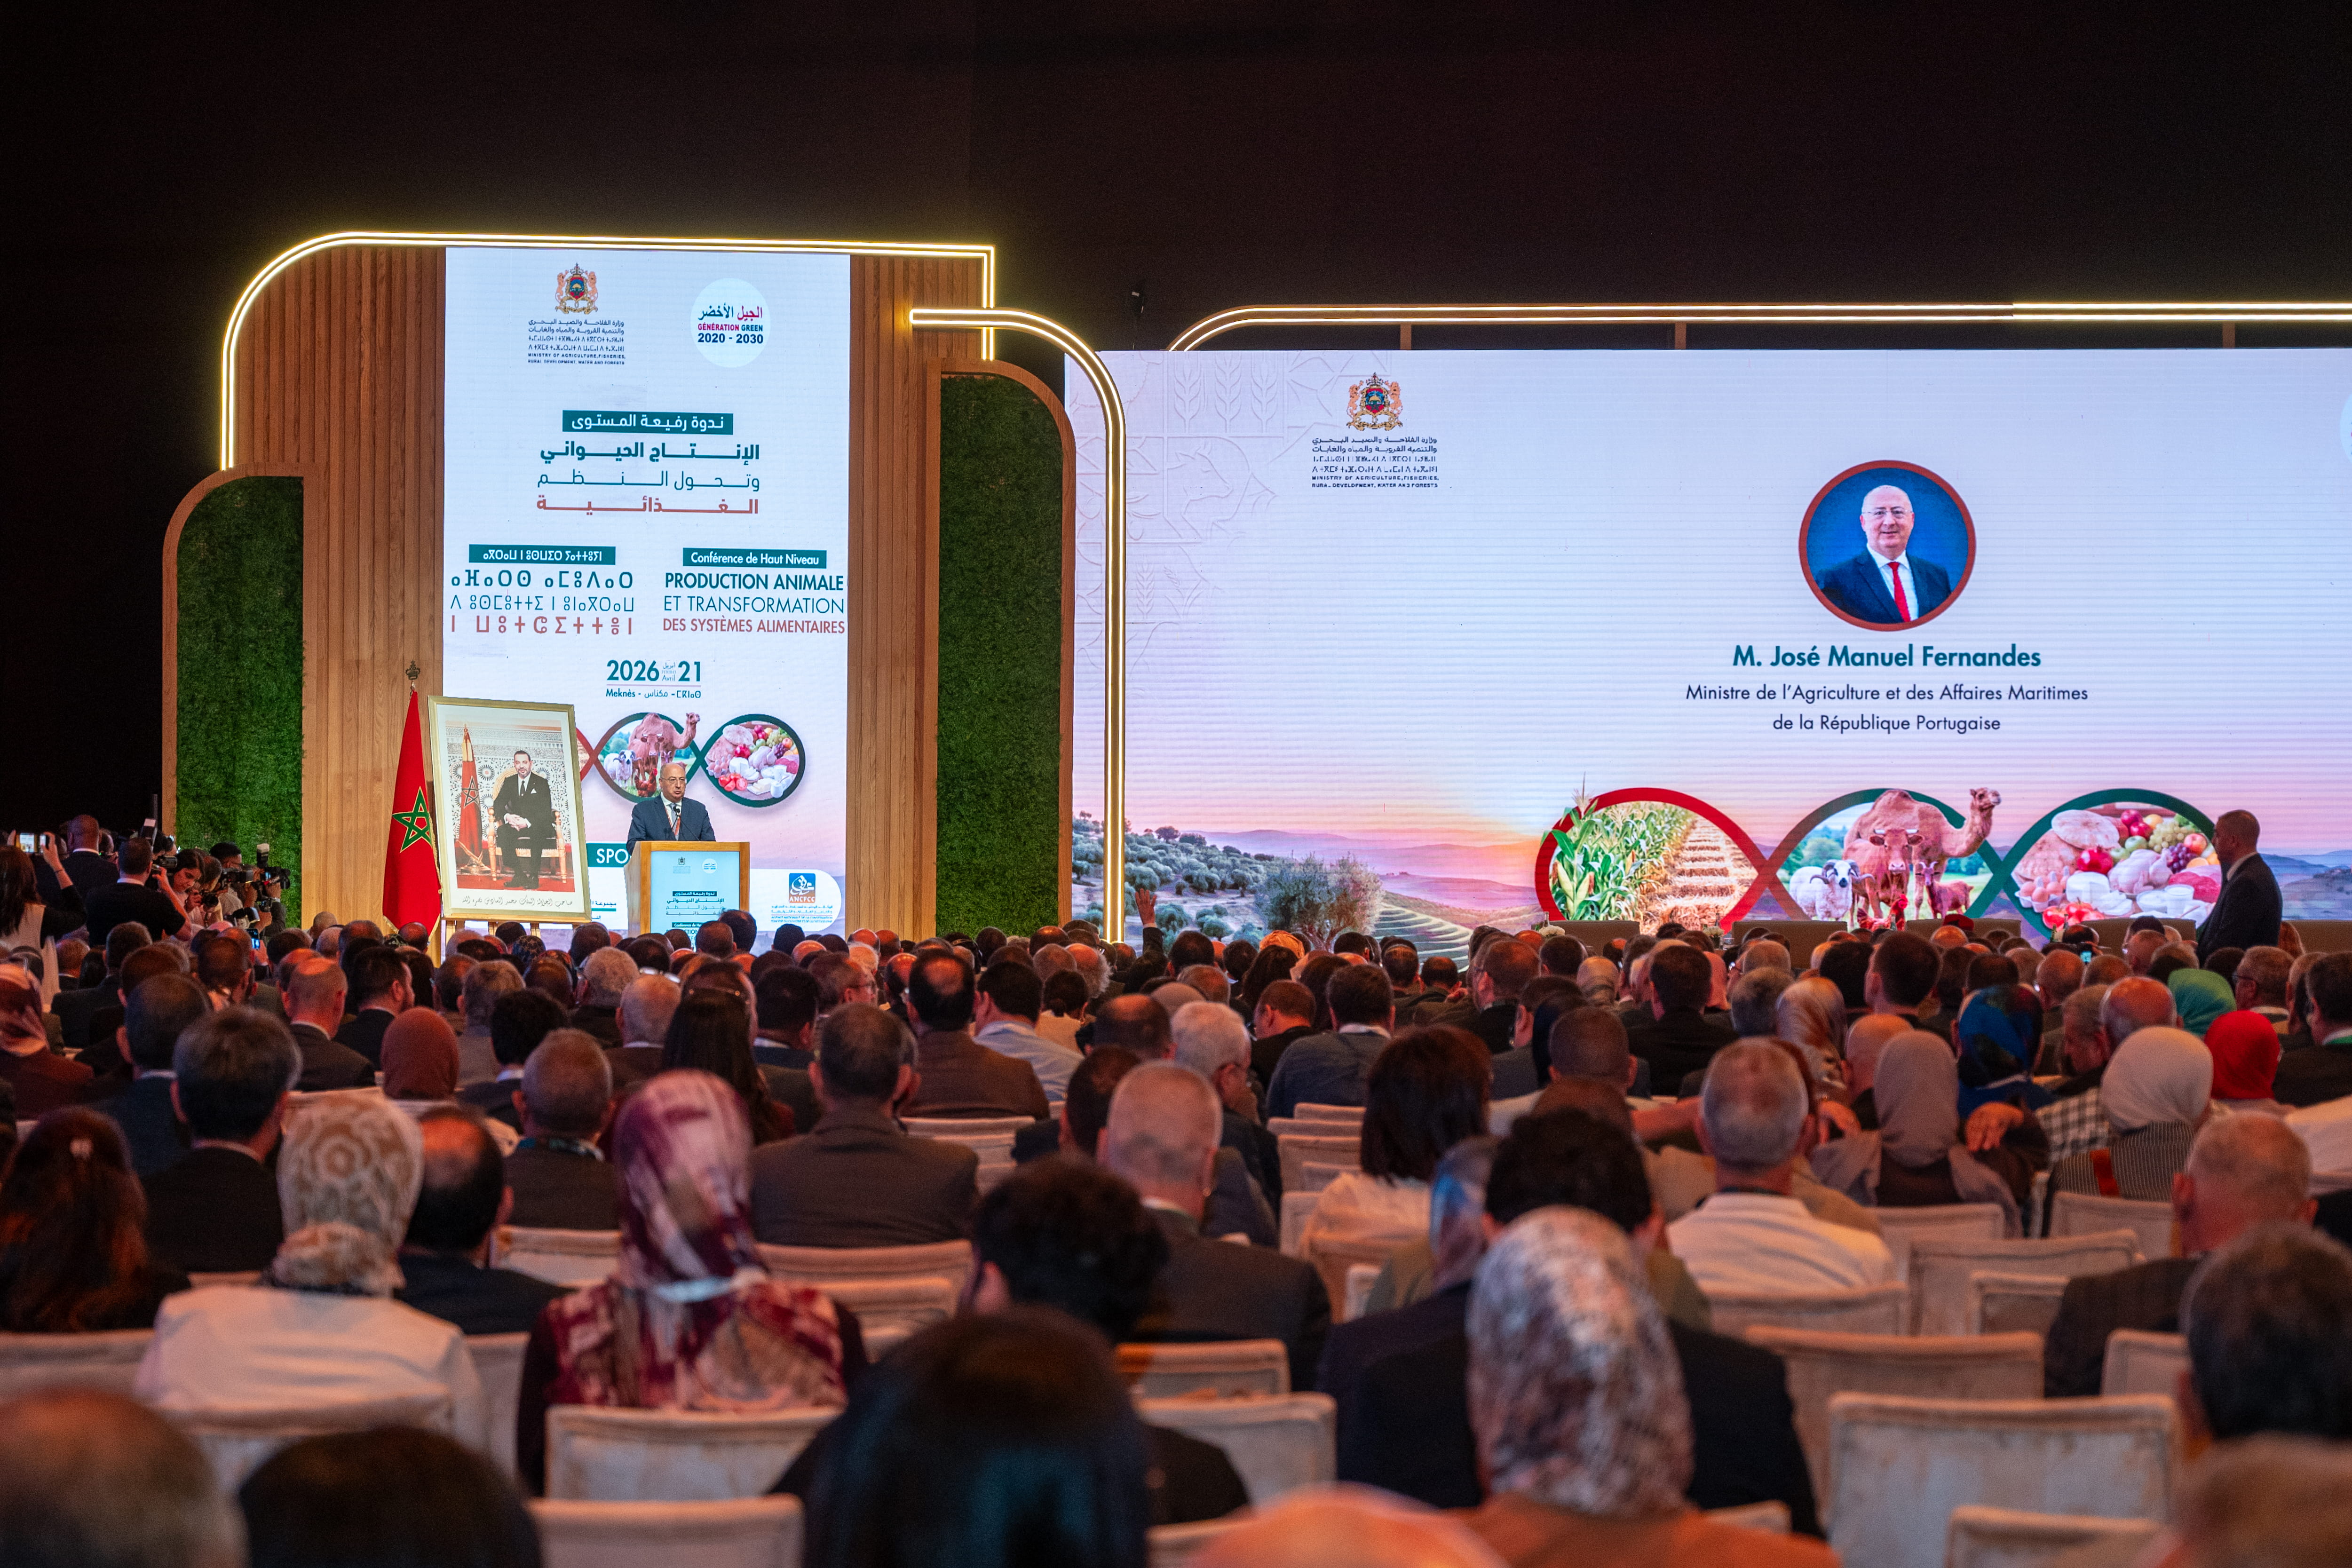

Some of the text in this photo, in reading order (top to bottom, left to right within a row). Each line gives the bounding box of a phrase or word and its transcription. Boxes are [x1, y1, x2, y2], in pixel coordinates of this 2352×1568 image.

[698, 302, 762, 321] الجيل الأخضر
[698, 322, 739, 331] GÉNÉRATION
[698, 333, 725, 343] 2020
[736, 334, 763, 343] 2030
[572, 414, 724, 431] ندوة رفيعة المستوى
[540, 441, 760, 466] الإنتاج الحيواني
[538, 469, 760, 491] وتحول النظم
[537, 495, 758, 515] الغذائية
[691, 552, 819, 564] Conférence de Haut Niveau
[665, 573, 843, 590] PRODUCTION ANIMALE
[665, 596, 844, 613] ET TRANSFORMATION
[663, 615, 845, 634] DES SYSTÈMES ALIMENTAIRES
[1733, 643, 2041, 666] M. José Manuel Fernandes
[607, 660, 659, 681] 2026
[678, 661, 700, 681] 21
[606, 688, 635, 697] Meknès
[644, 689, 668, 698] مكناس
[1686, 685, 1750, 700] Ministre
[1756, 684, 1776, 700] de
[1886, 687, 1901, 700] et
[1907, 684, 1933, 700] des
[1940, 684, 2002, 700] Affaires
[2008, 685, 2088, 700] Maritimes
[1773, 715, 2000, 734] de la République Portugaise
[519, 895, 535, 905] الملك
